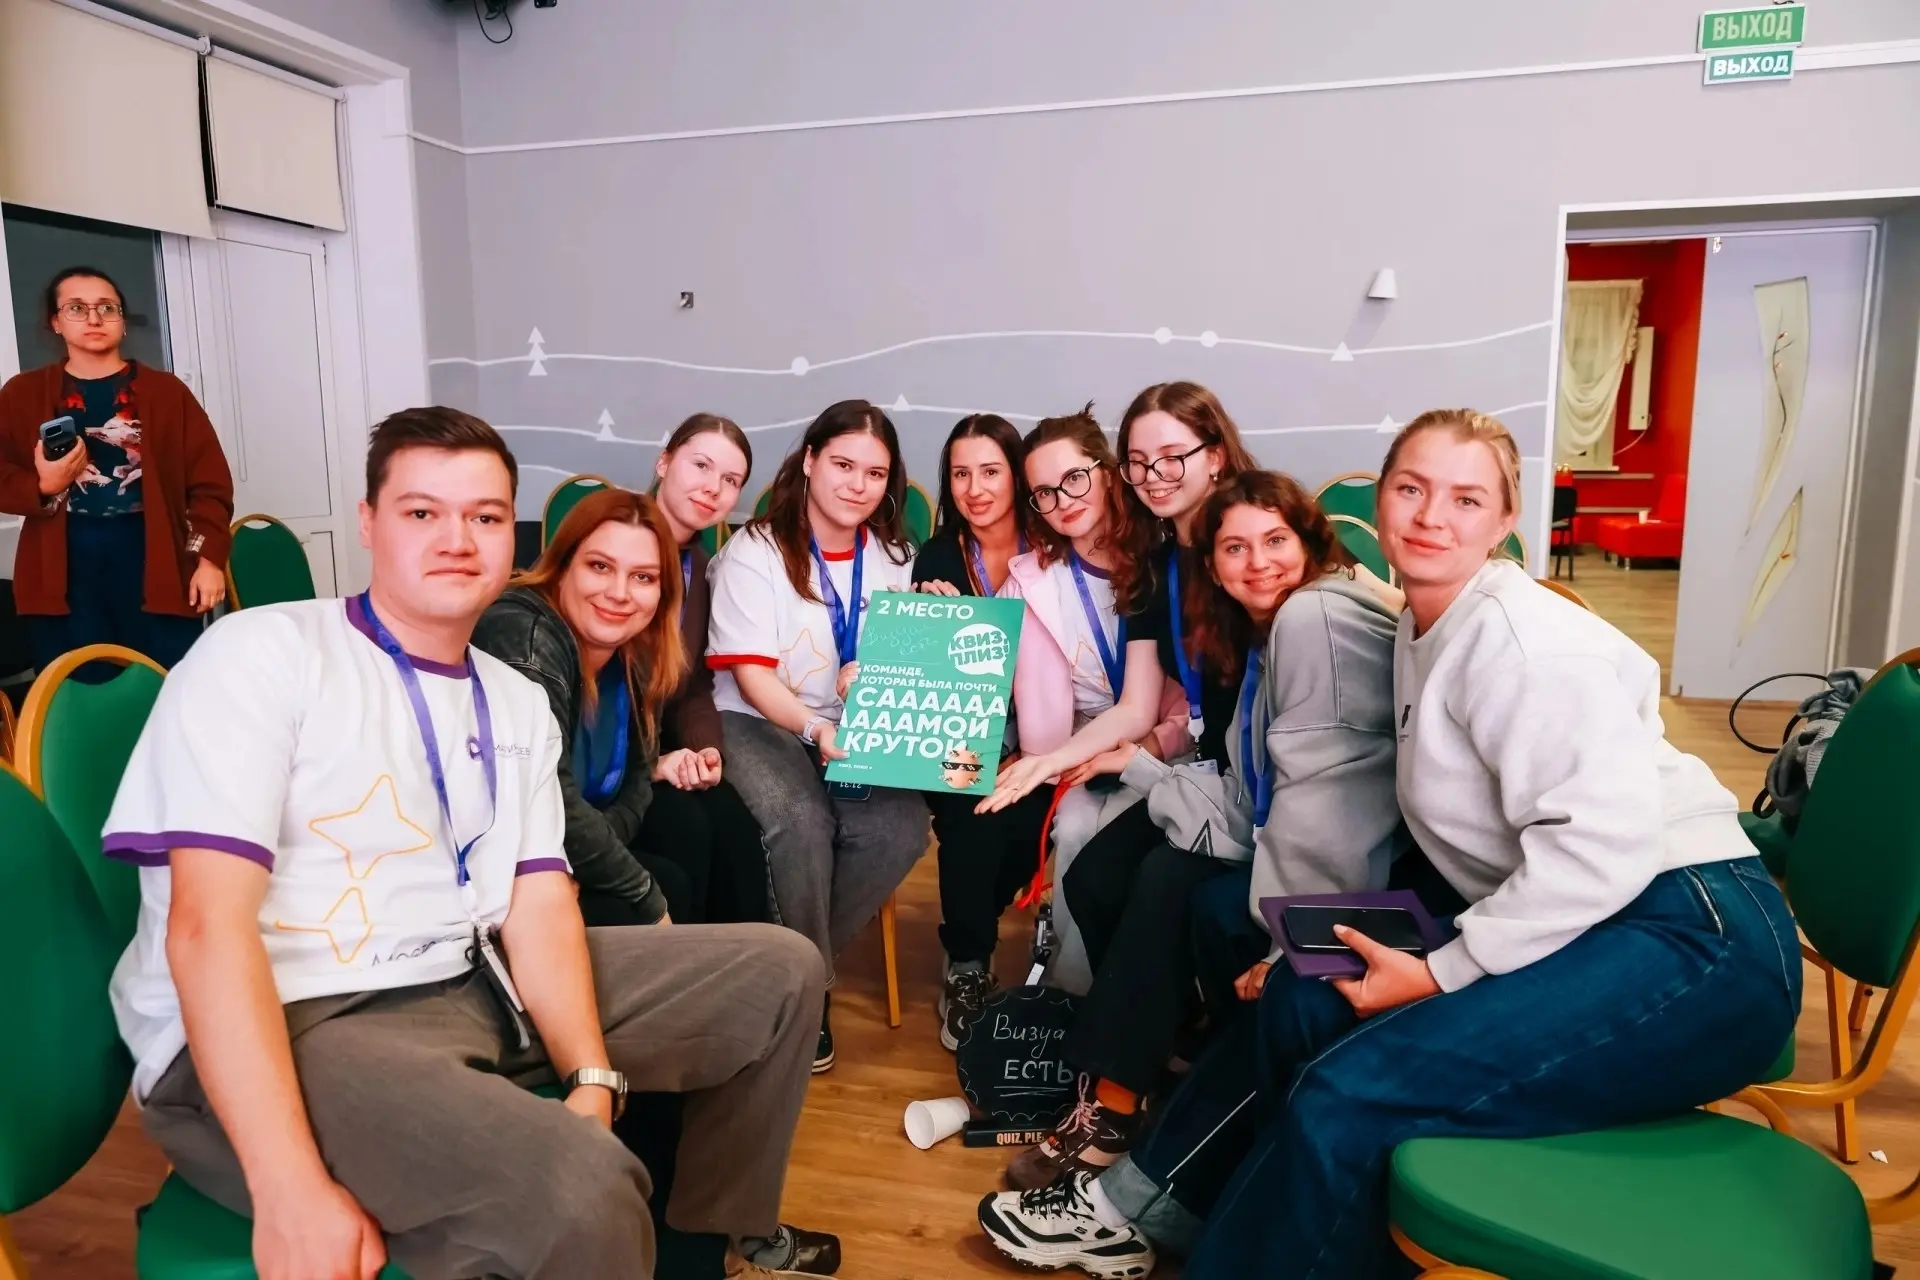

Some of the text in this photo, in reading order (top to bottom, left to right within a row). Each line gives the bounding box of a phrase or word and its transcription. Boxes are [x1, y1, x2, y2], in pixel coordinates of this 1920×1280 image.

[1712, 11, 1793, 41] ВЫХОД
[1713, 55, 1789, 76] ВЫХОД
[877, 600, 974, 620] 2 МЕСТО
[951, 645, 1008, 666] ПЛИЗ!
[863, 664, 925, 677] КОМАНДЕ,
[860, 676, 997, 693] КОТОРАЯ БЫЛА ПОЧТИ
[856, 687, 1007, 717] САААААА
[993, 1013, 1066, 1059] Визуа
[1004, 1059, 1074, 1084] ЕСТЬ
[996, 1131, 1045, 1146] QUIZ, PLE
